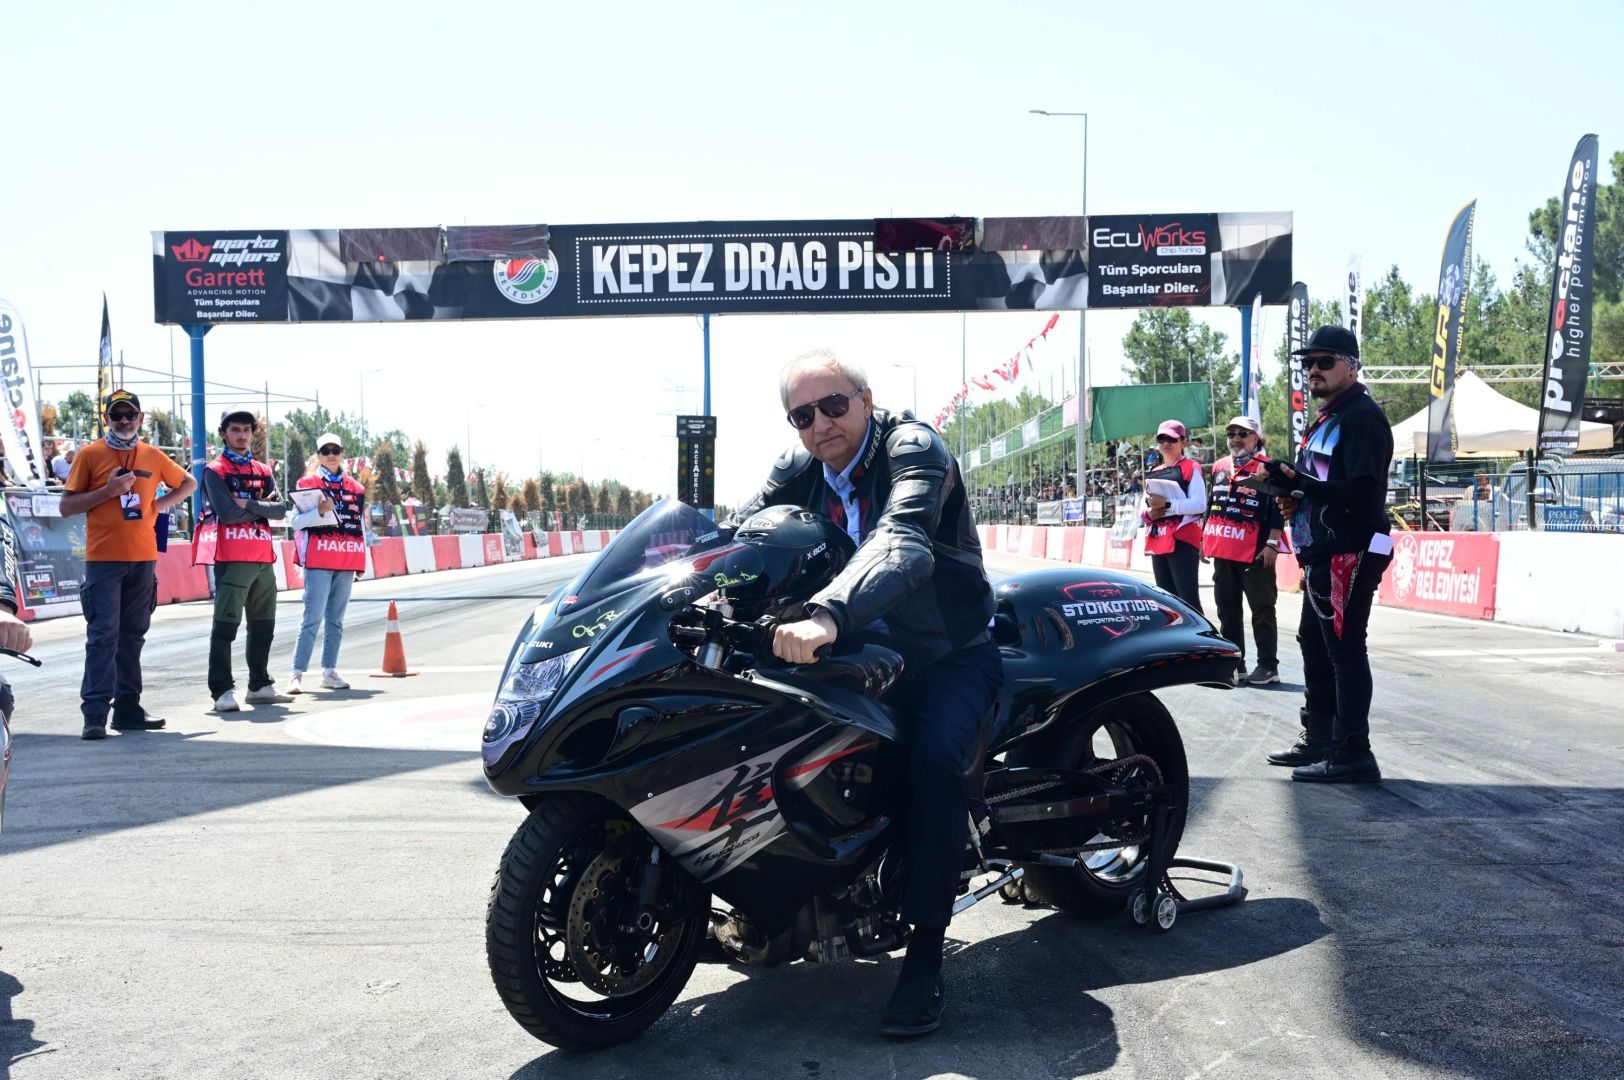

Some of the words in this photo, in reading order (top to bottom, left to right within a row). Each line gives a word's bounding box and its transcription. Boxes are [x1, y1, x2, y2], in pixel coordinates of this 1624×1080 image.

[1571, 159, 1591, 287] performance
[212, 234, 279, 253] marka
[208, 249, 281, 267] motors
[592, 243, 714, 294] KEPEZ
[725, 241, 827, 291] DRAG
[185, 268, 265, 287] Garrett
[1098, 264, 1128, 275] Tüm
[1131, 263, 1202, 276] Sporculara
[1102, 283, 1161, 297] Başarılar
[1544, 160, 1584, 412] prooctane
[194, 298, 213, 306] Tüm
[215, 298, 260, 307] Sporculara
[1566, 294, 1584, 358] higher
[317, 539, 364, 552] HAKEM
[1419, 540, 1454, 568] KEPEZ
[26, 573, 51, 587] PLUS
